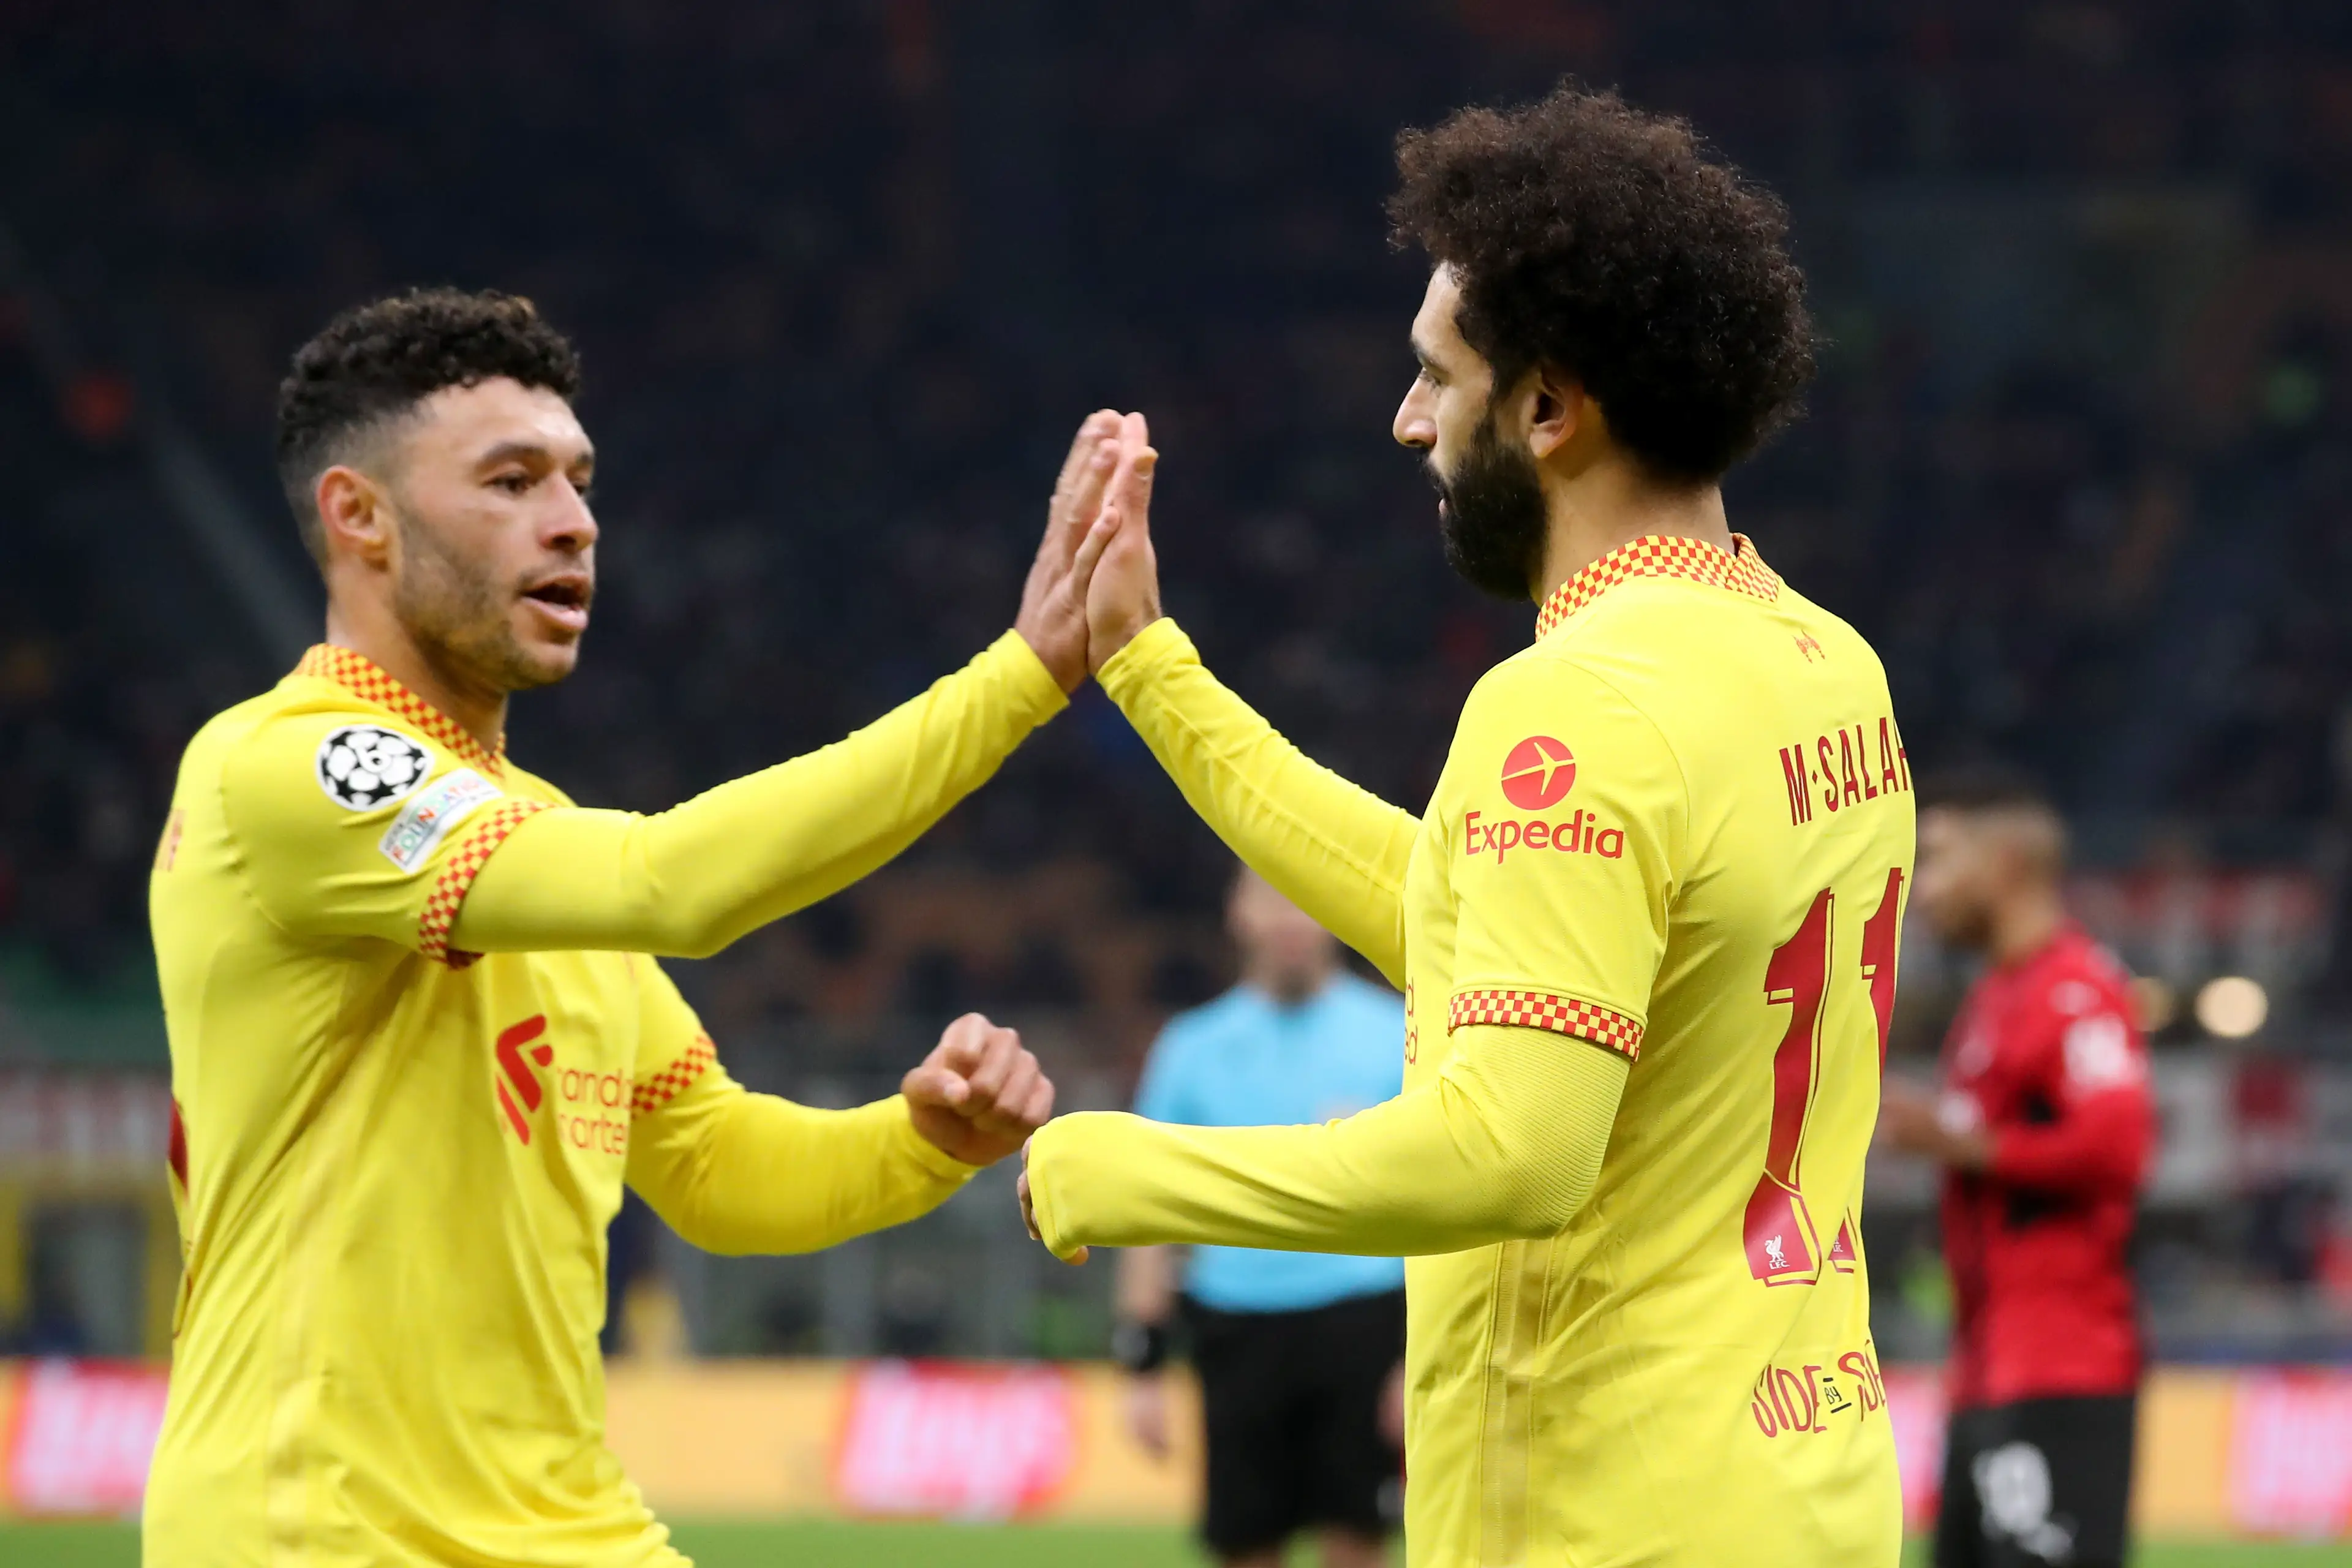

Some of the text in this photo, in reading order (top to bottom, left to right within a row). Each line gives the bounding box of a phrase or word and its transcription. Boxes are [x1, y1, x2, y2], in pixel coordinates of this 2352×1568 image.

[1465, 809, 1624, 865] Expedia
[1751, 1363, 1828, 1438] SIDE
[1823, 1385, 1842, 1405] BY
